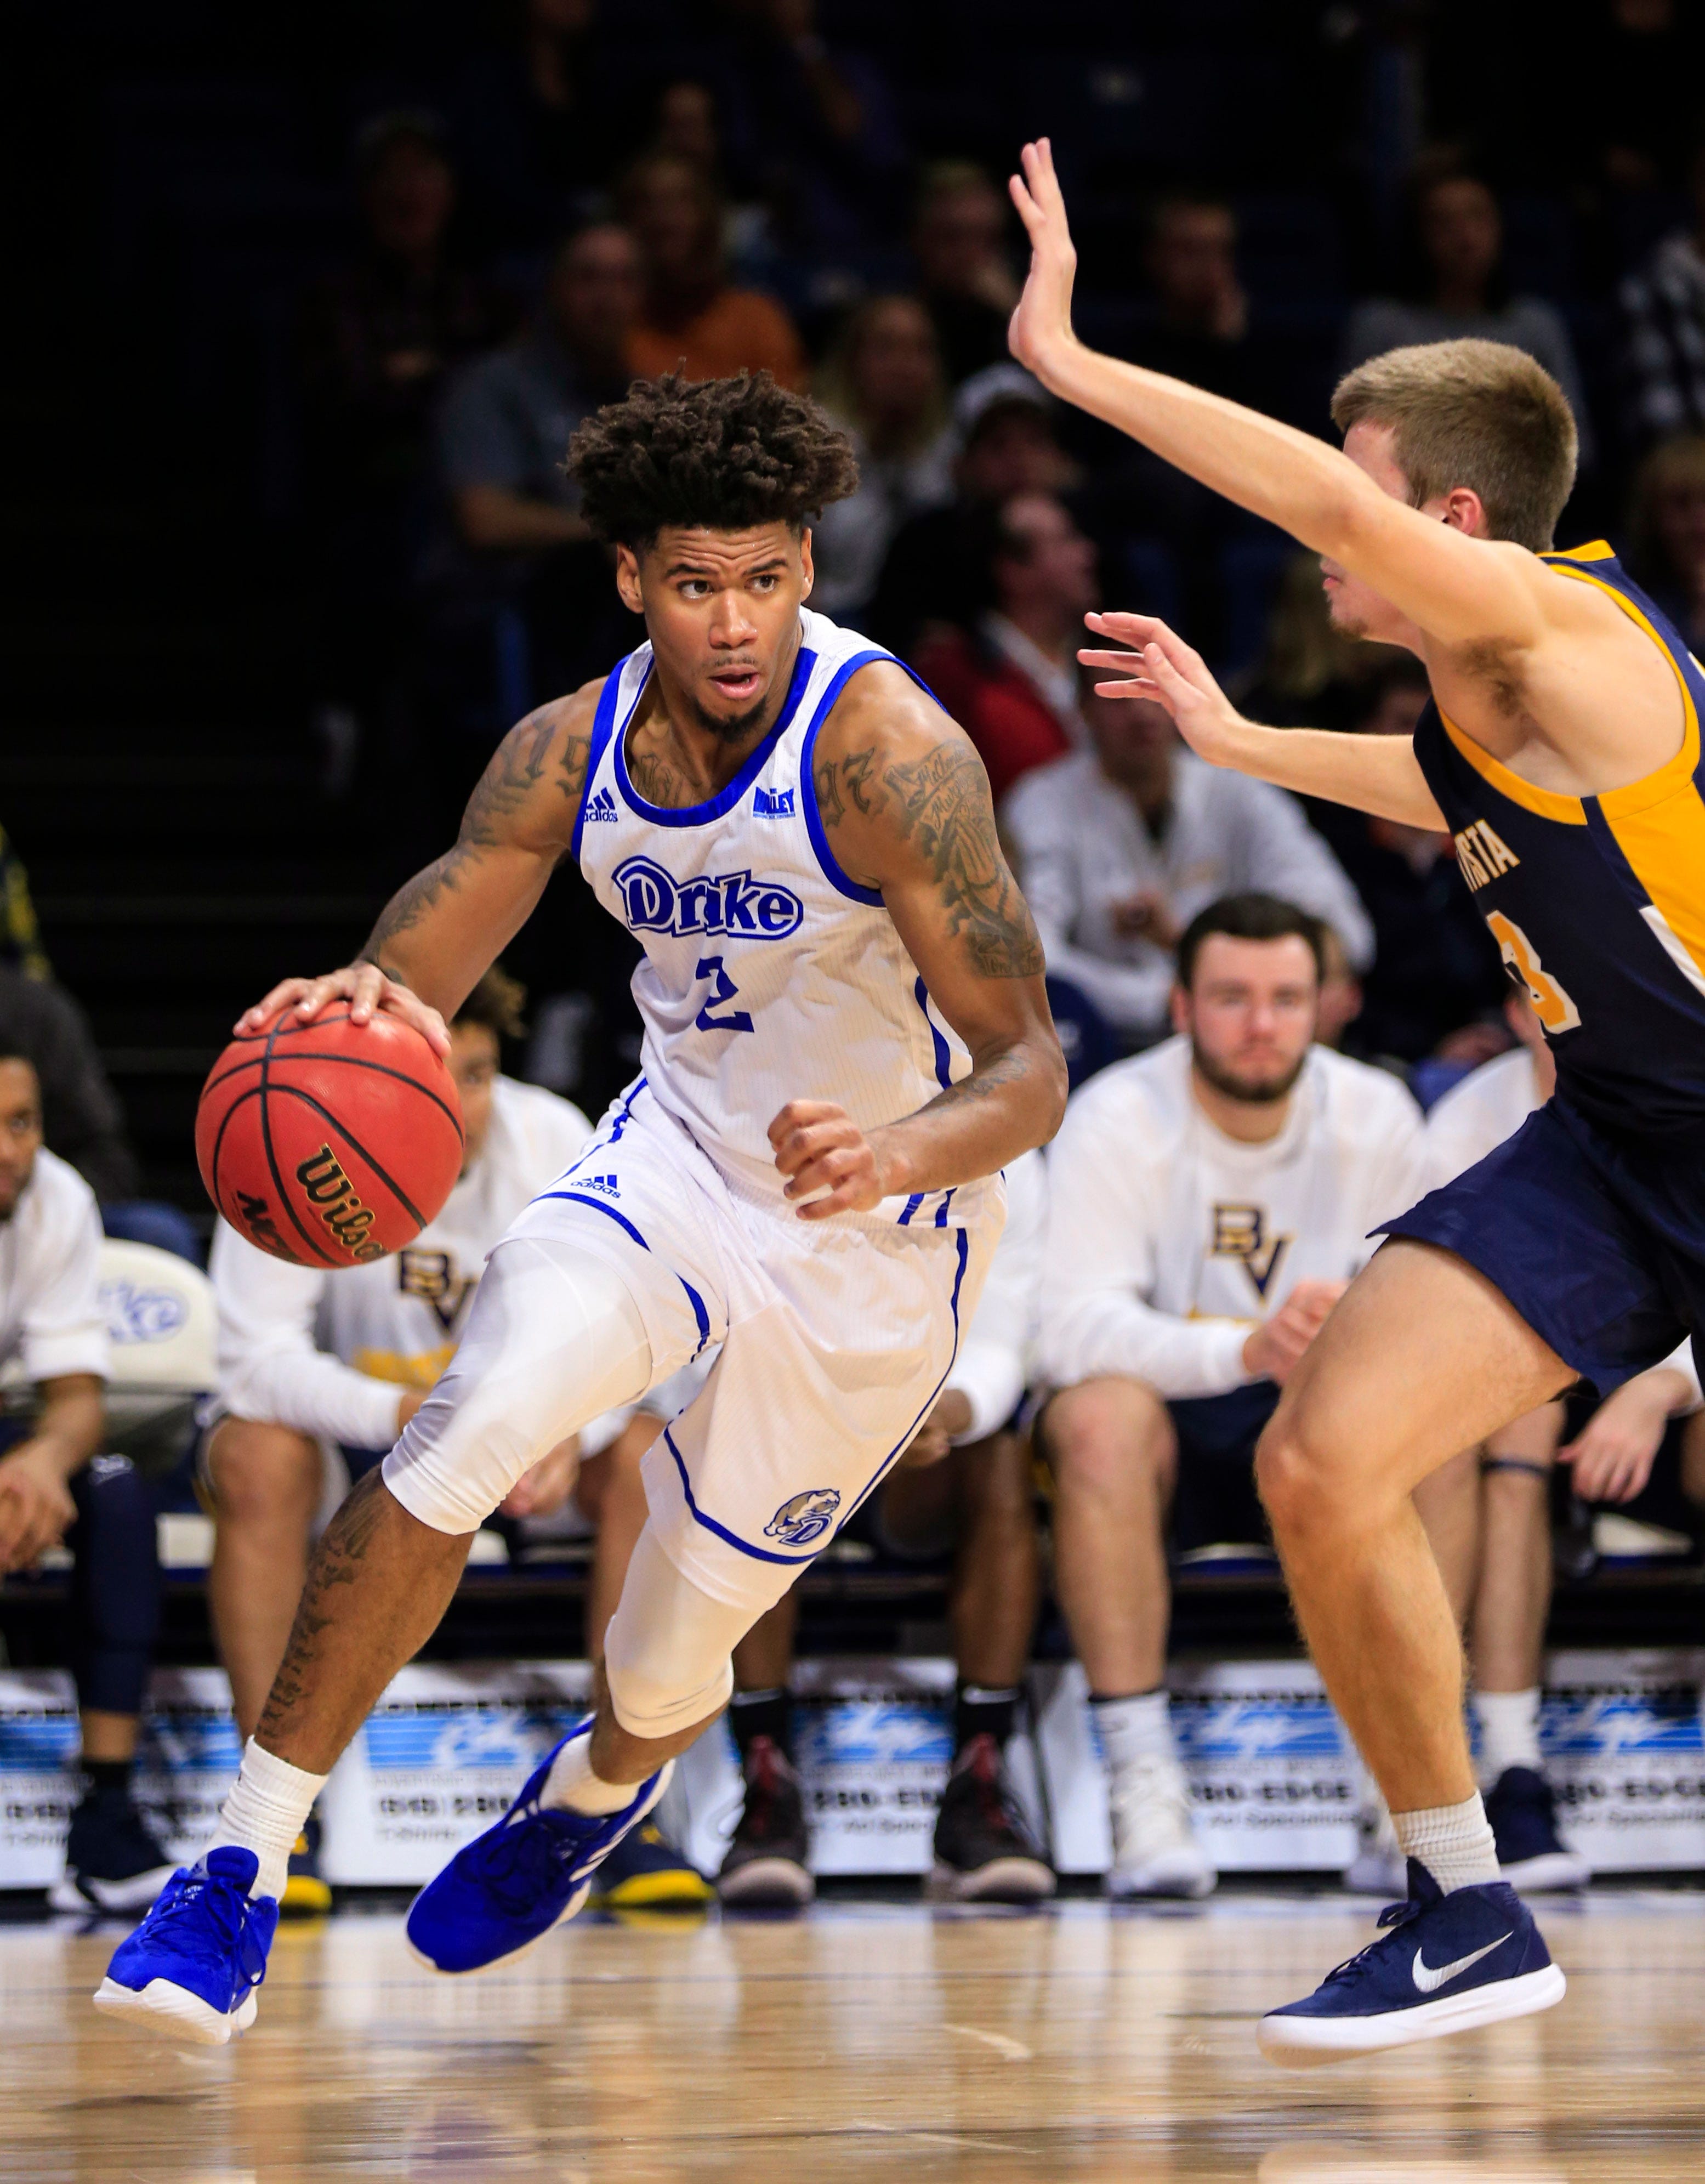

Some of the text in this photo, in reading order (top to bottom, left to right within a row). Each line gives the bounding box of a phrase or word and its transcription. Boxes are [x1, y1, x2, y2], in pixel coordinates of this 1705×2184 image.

[583, 809, 618, 822] adidas
[695, 955, 755, 1033] 2
[296, 1142, 390, 1263] Wilso
[571, 1178, 622, 1199] adidas
[1210, 1200, 1295, 1308] BV
